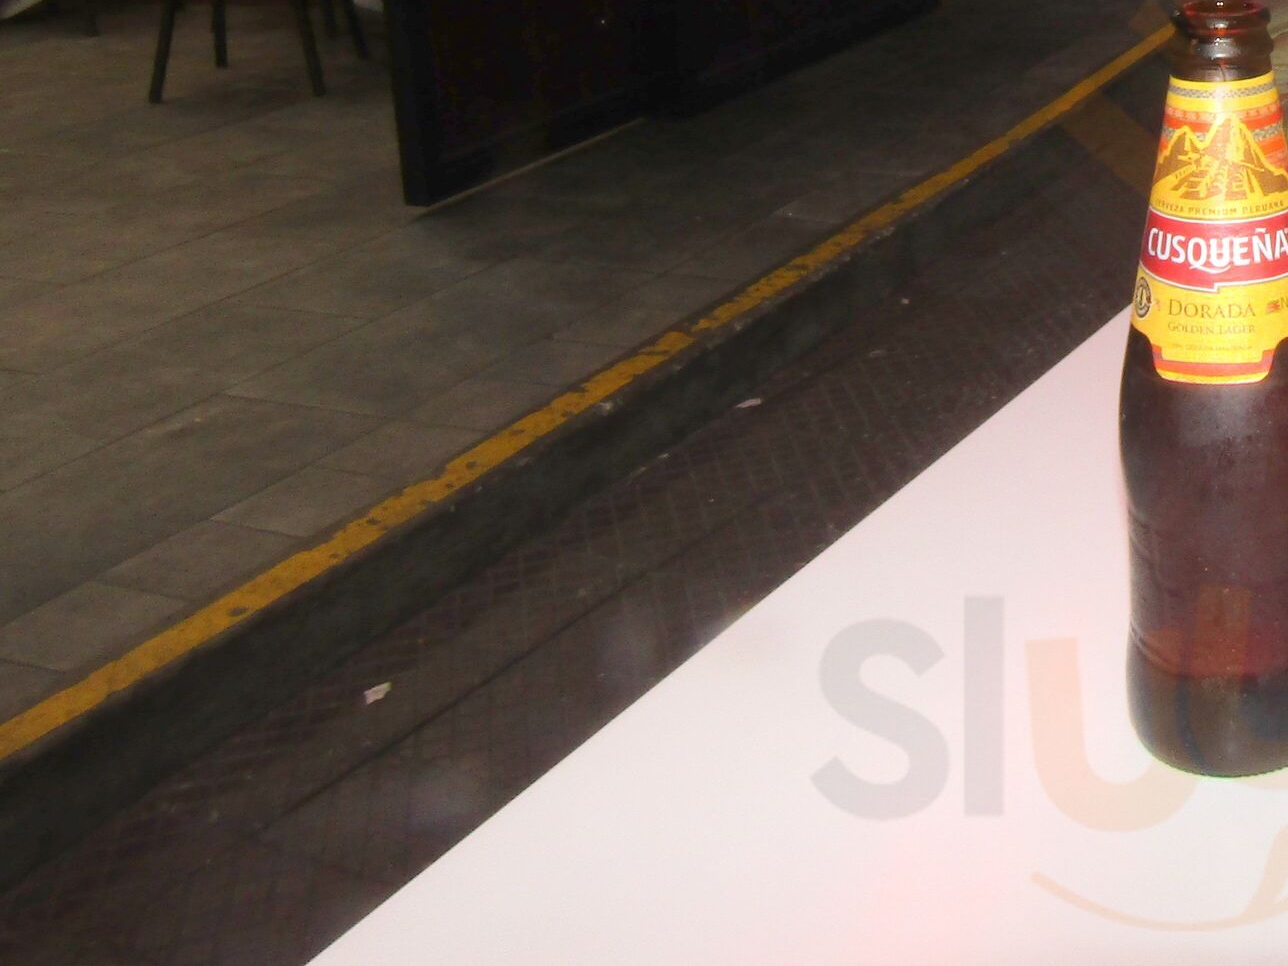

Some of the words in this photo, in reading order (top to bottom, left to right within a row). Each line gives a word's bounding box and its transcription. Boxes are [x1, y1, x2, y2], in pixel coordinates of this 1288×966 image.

[1187, 206, 1237, 216] PREMIUM
[1241, 200, 1285, 213] PERUANA
[1167, 298, 1257, 319] DORADA
